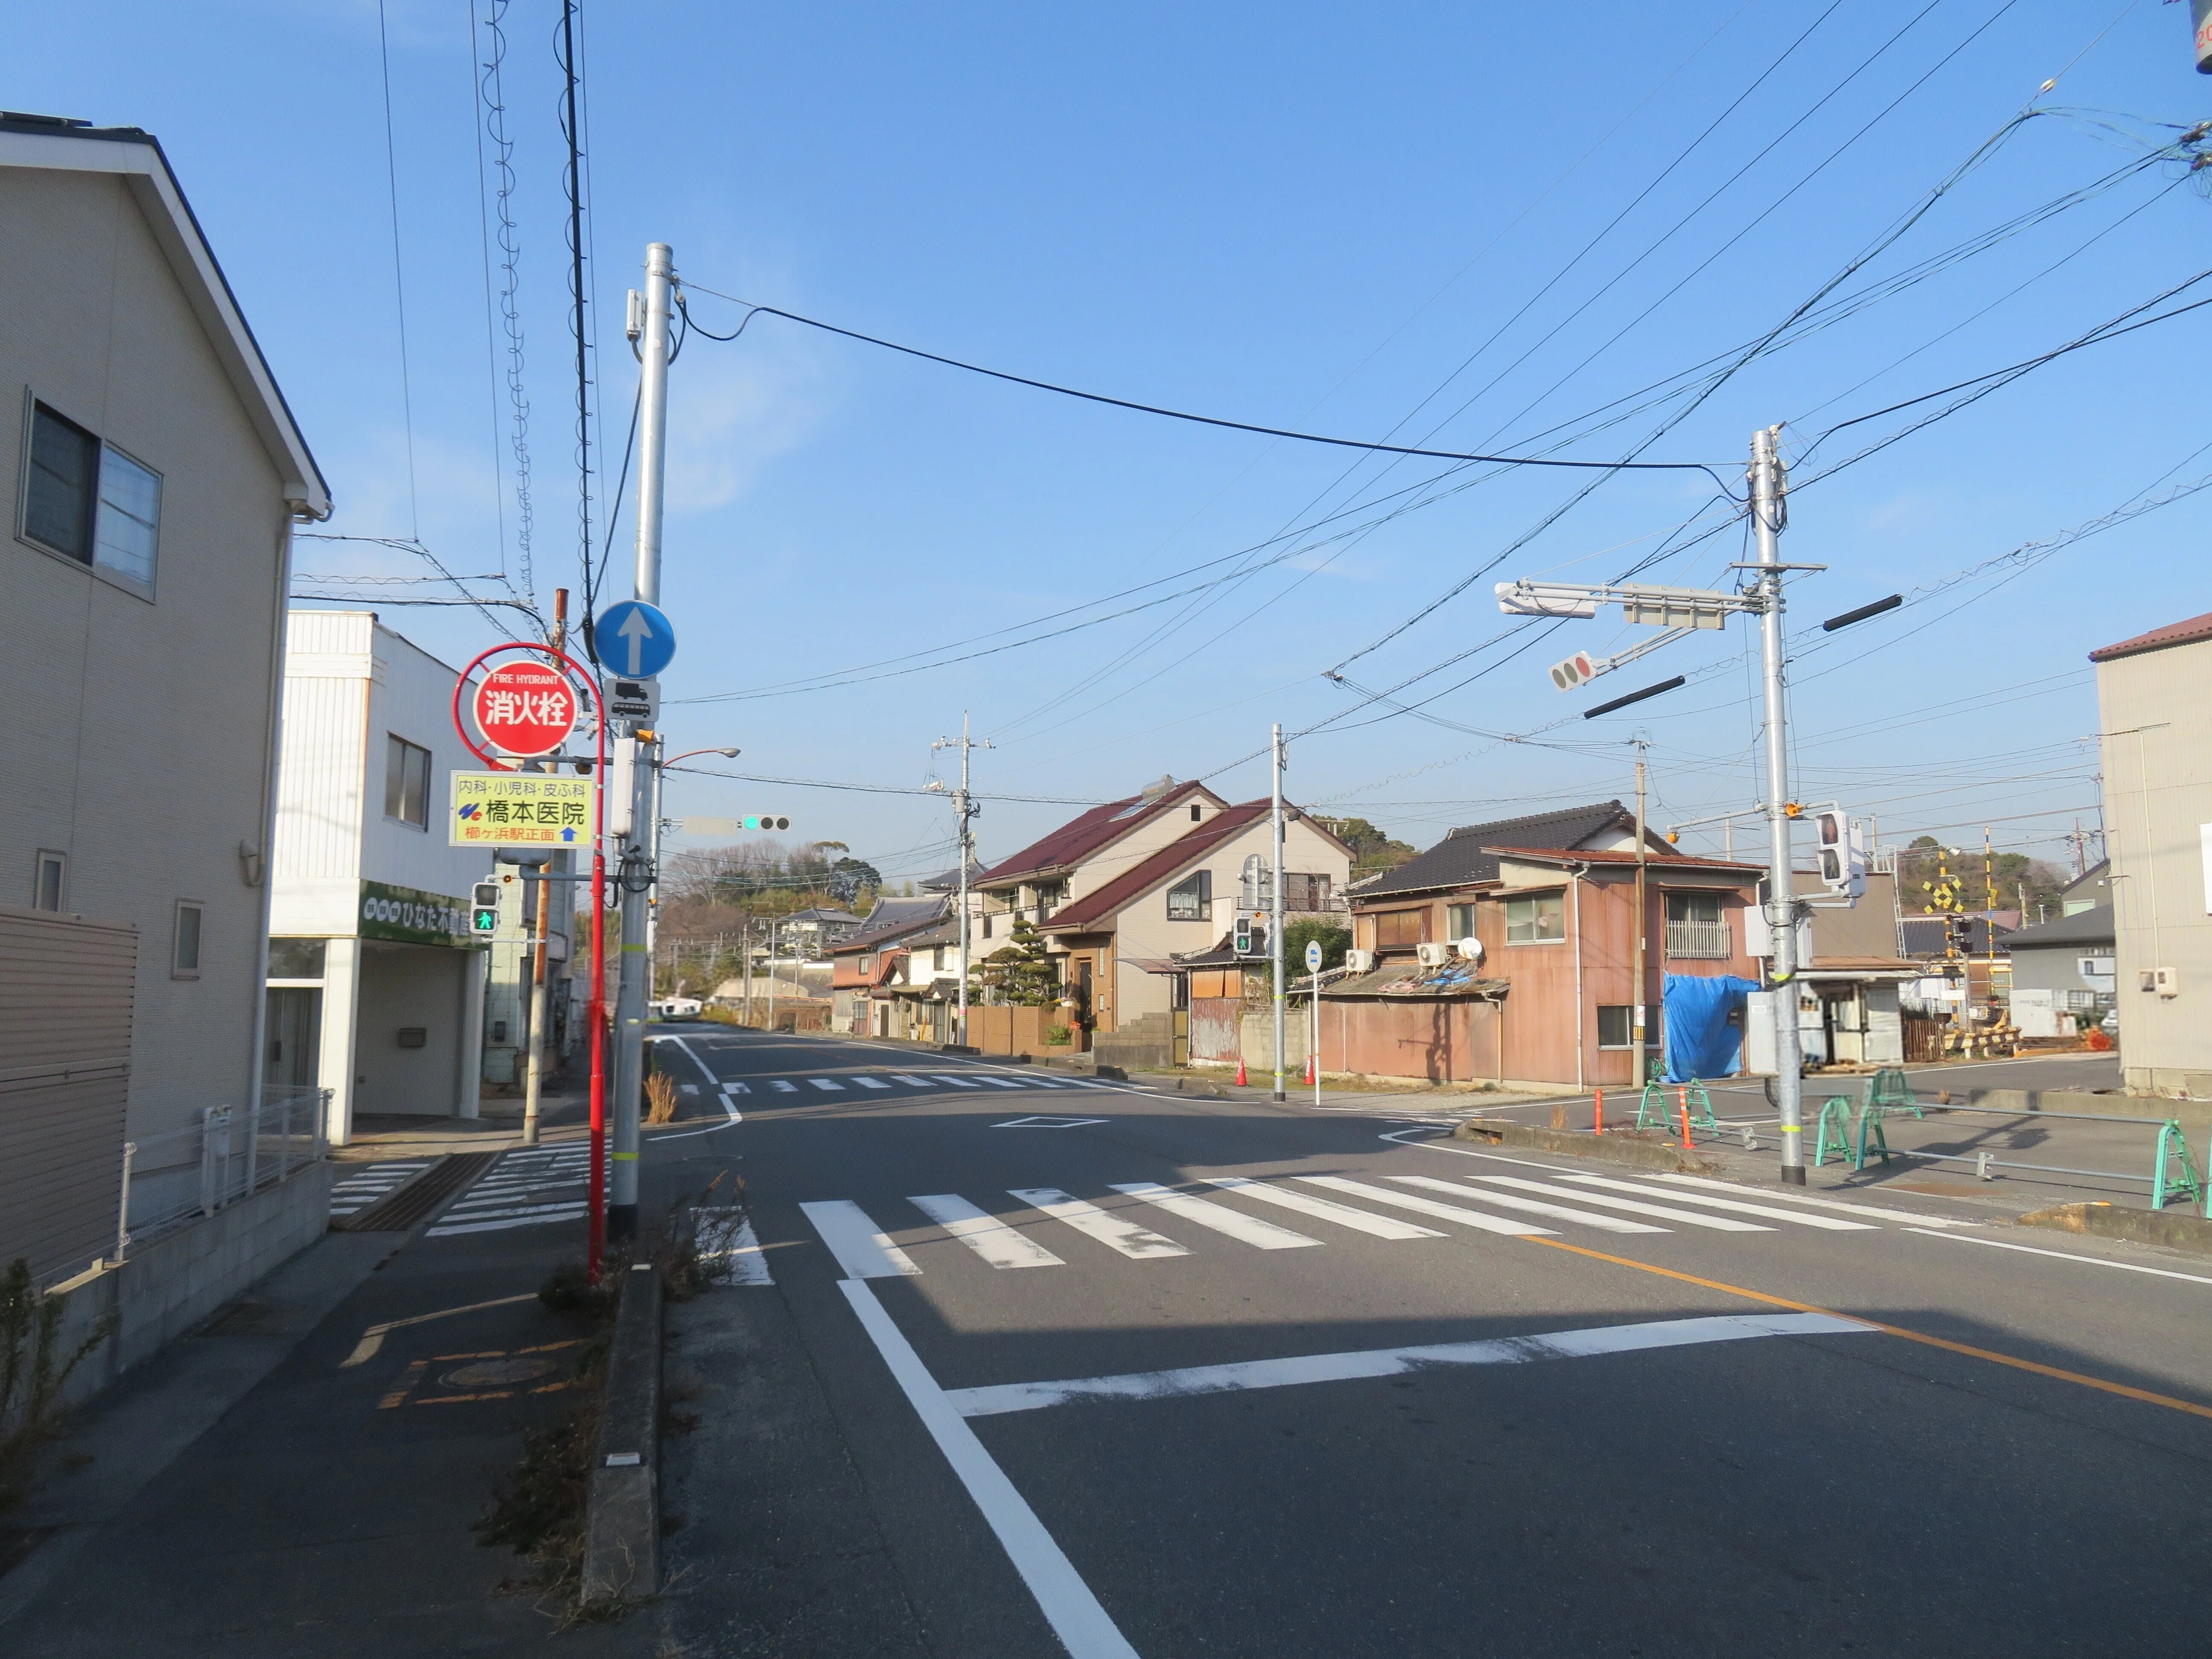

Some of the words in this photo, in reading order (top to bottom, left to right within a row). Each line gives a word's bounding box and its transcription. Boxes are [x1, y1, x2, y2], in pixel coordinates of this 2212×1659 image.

[493, 673, 513, 684] FIRE
[516, 674, 559, 684] HYDRANT
[486, 690, 568, 726] 消火栓
[486, 799, 585, 825] 橋本医院
